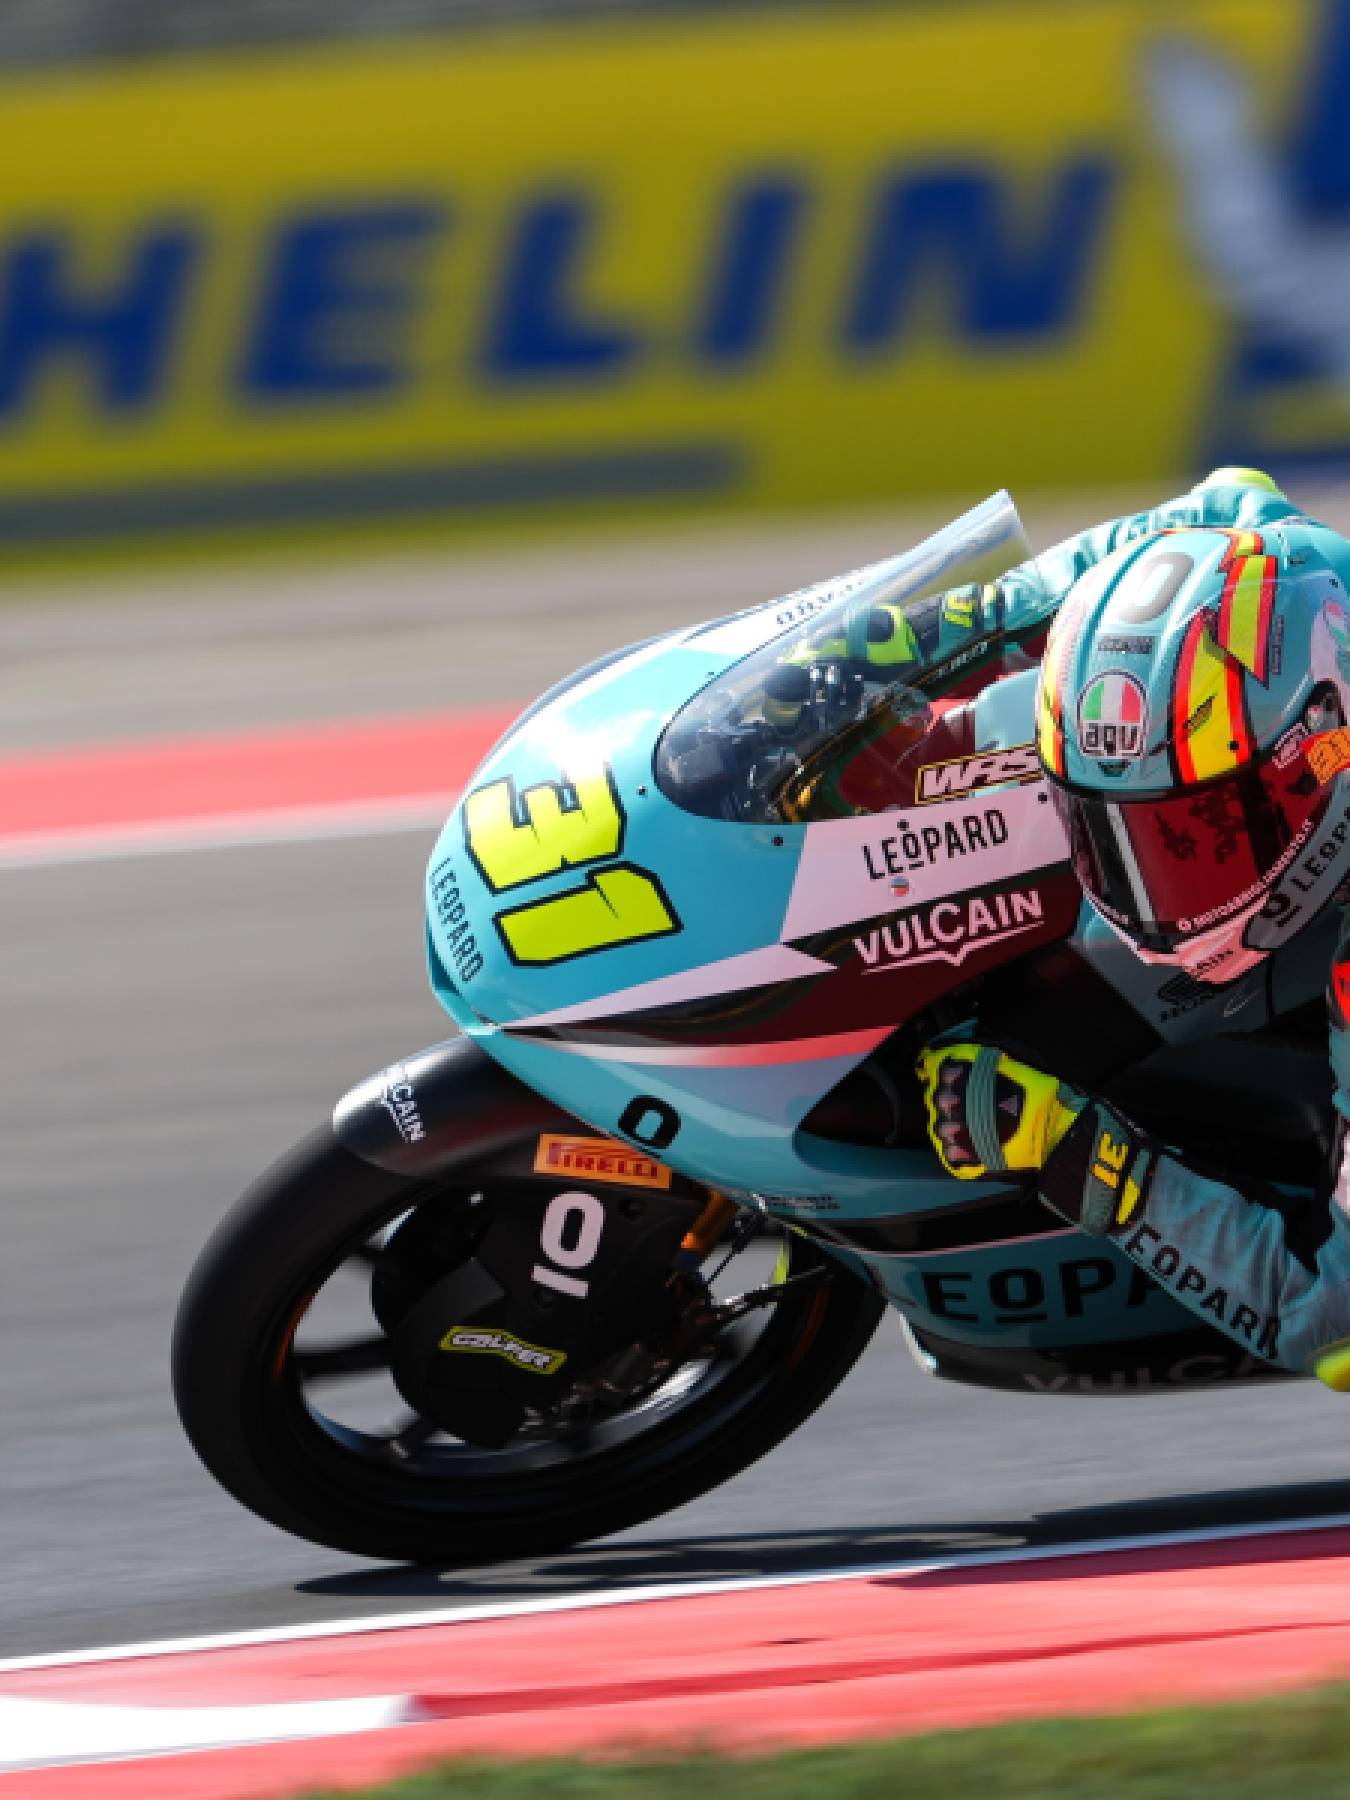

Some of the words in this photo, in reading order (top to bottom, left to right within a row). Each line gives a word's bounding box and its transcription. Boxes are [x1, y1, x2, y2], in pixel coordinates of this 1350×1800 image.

[462, 758, 684, 967] 31
[862, 808, 1008, 881] LEOPARD
[430, 856, 484, 983] LEOPARD
[853, 889, 1043, 967] VULCAIN
